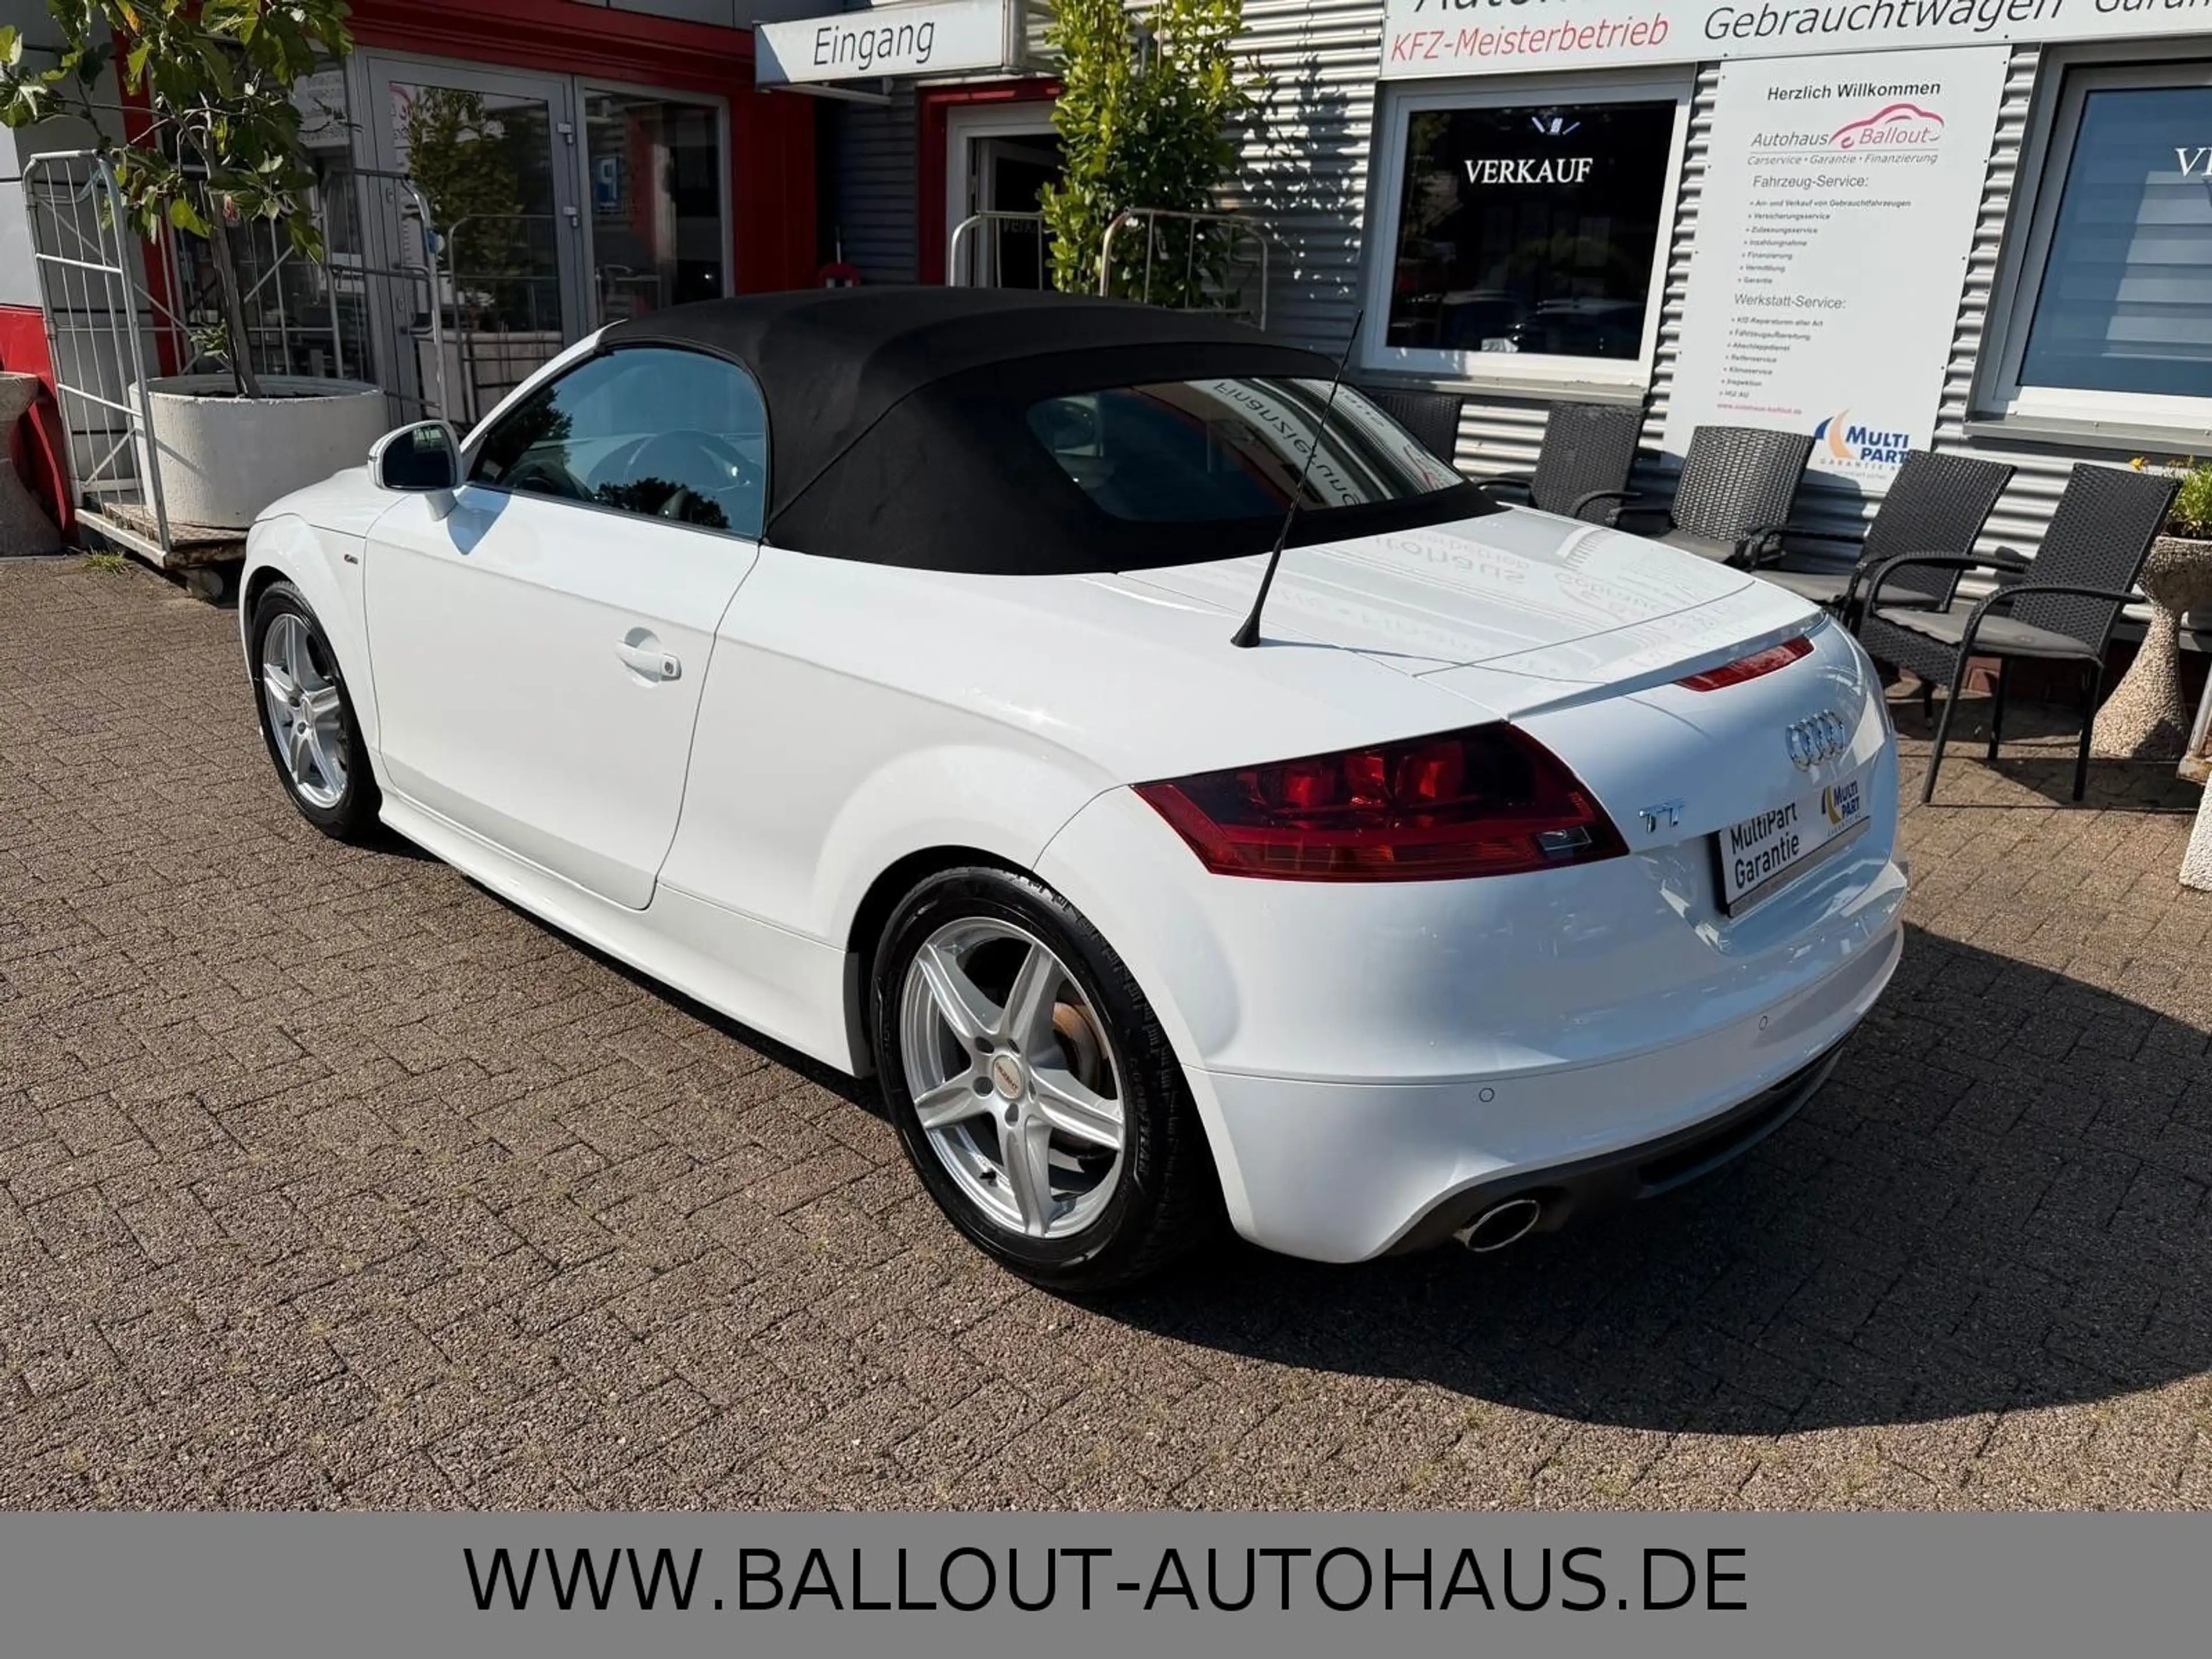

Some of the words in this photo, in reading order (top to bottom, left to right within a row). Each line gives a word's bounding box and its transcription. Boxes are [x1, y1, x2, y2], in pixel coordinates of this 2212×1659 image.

[1705, 0, 2062, 40] Gebrauchtwagen
[813, 21, 935, 70] Eingang
[1391, 13, 1669, 61] KFZ-Meisterbetrieb
[1767, 85, 1831, 101] Herzlich
[1837, 82, 1941, 99] Willkommen
[1751, 132, 1829, 146] Autohaus
[1859, 127, 1930, 145] Ballout
[1465, 158, 1593, 184] VERKAUF
[1748, 156, 1801, 165] Carservice
[1809, 154, 1856, 164] Garantie
[1865, 153, 1938, 165] Finanzierung
[1753, 175, 1869, 190] Fahrzeug-Service:
[1734, 294, 1846, 309] Werkstatt-Service:
[1846, 426, 1909, 448] MULTI
[1639, 798, 1685, 833] TT
[1842, 796, 1860, 818] PART
[1730, 802, 1797, 854] MultiPart
[1735, 832, 1800, 889] Garantie
